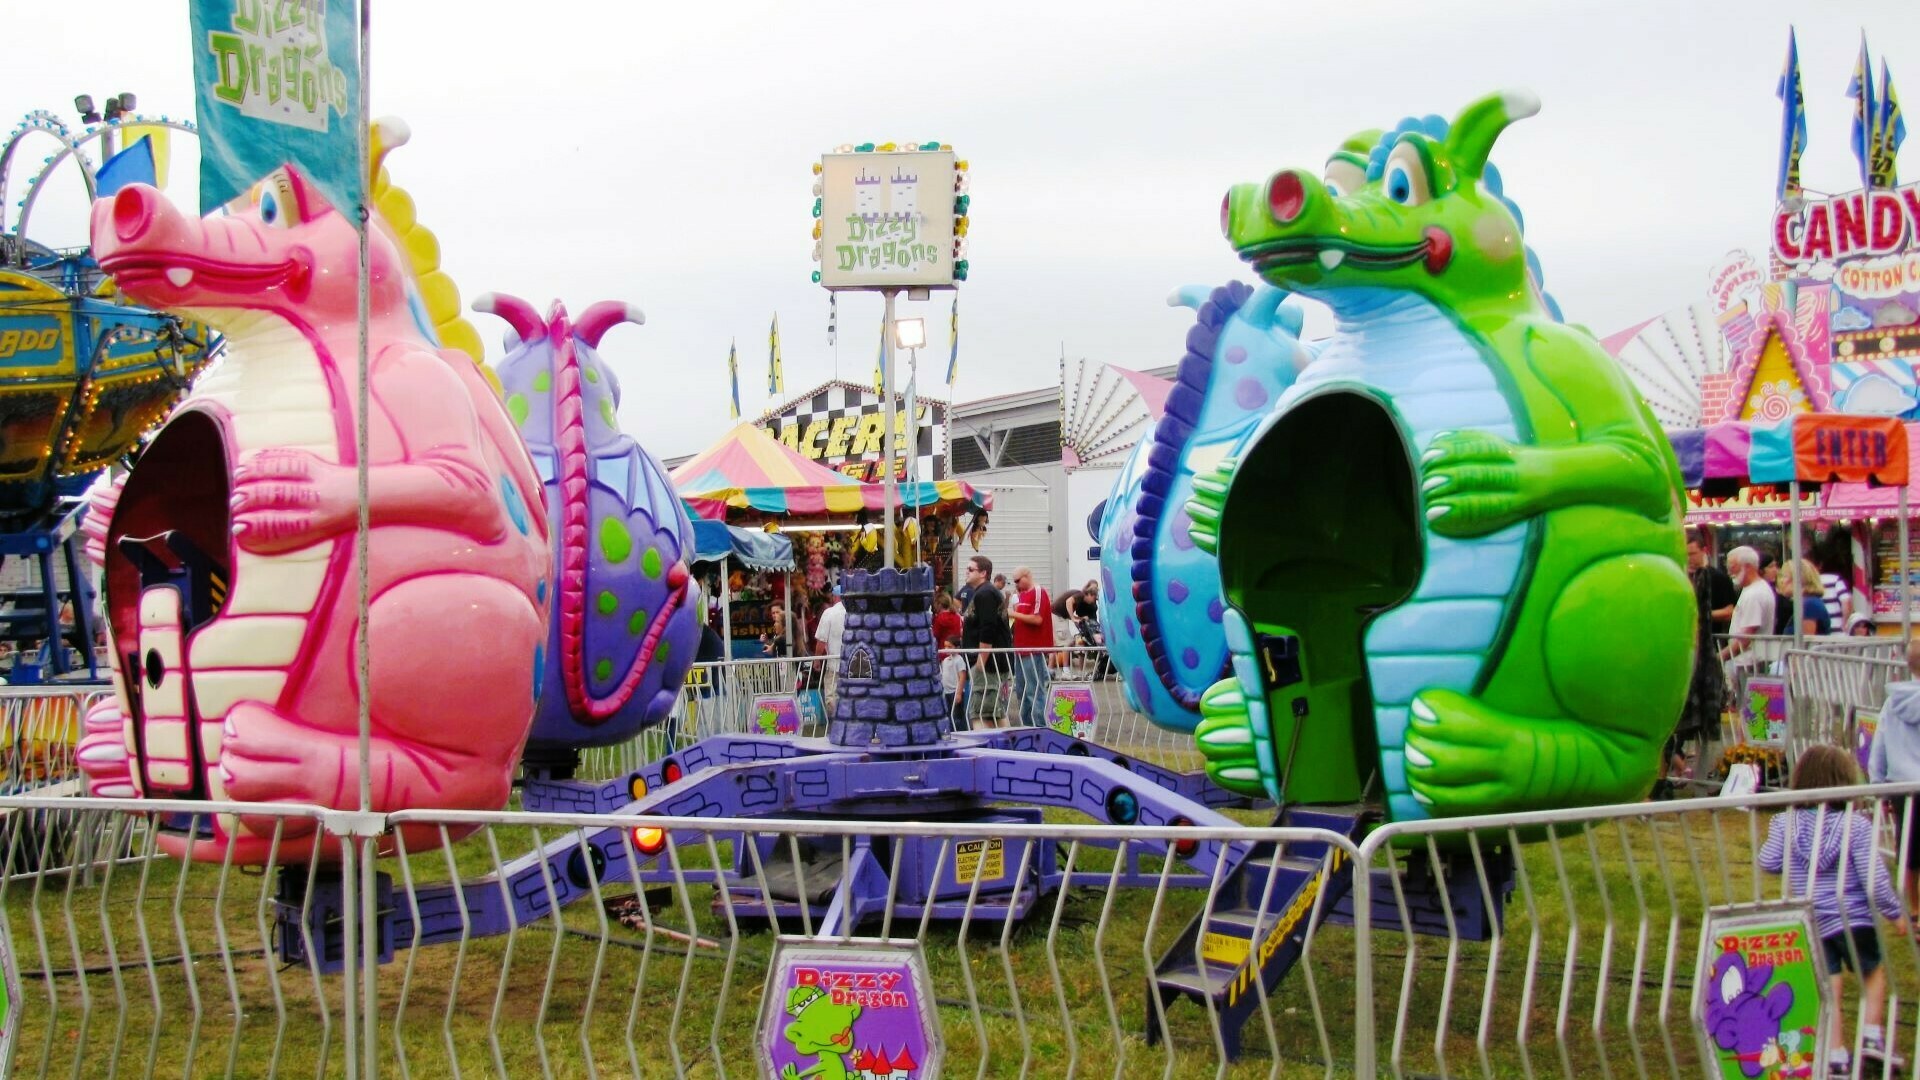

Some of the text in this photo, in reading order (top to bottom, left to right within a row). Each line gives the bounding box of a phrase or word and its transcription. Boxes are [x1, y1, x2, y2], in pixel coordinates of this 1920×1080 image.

[211, 33, 347, 118] Dragons
[845, 214, 917, 246] Dizzy
[1774, 187, 1920, 260] CANDY
[836, 242, 938, 272] Dragons
[1841, 264, 1902, 292] COTTON
[764, 406, 926, 459] ACER
[1815, 428, 1887, 468] ENTER
[1729, 511, 1775, 519] POPCORN
[1799, 508, 1856, 516] NO-CONES
[967, 841, 1001, 852] CAUON
[1723, 931, 1799, 952] Dizzy
[1747, 948, 1804, 968] Dragon
[795, 967, 902, 990] Dizzy
[830, 988, 909, 1009] Dragon
